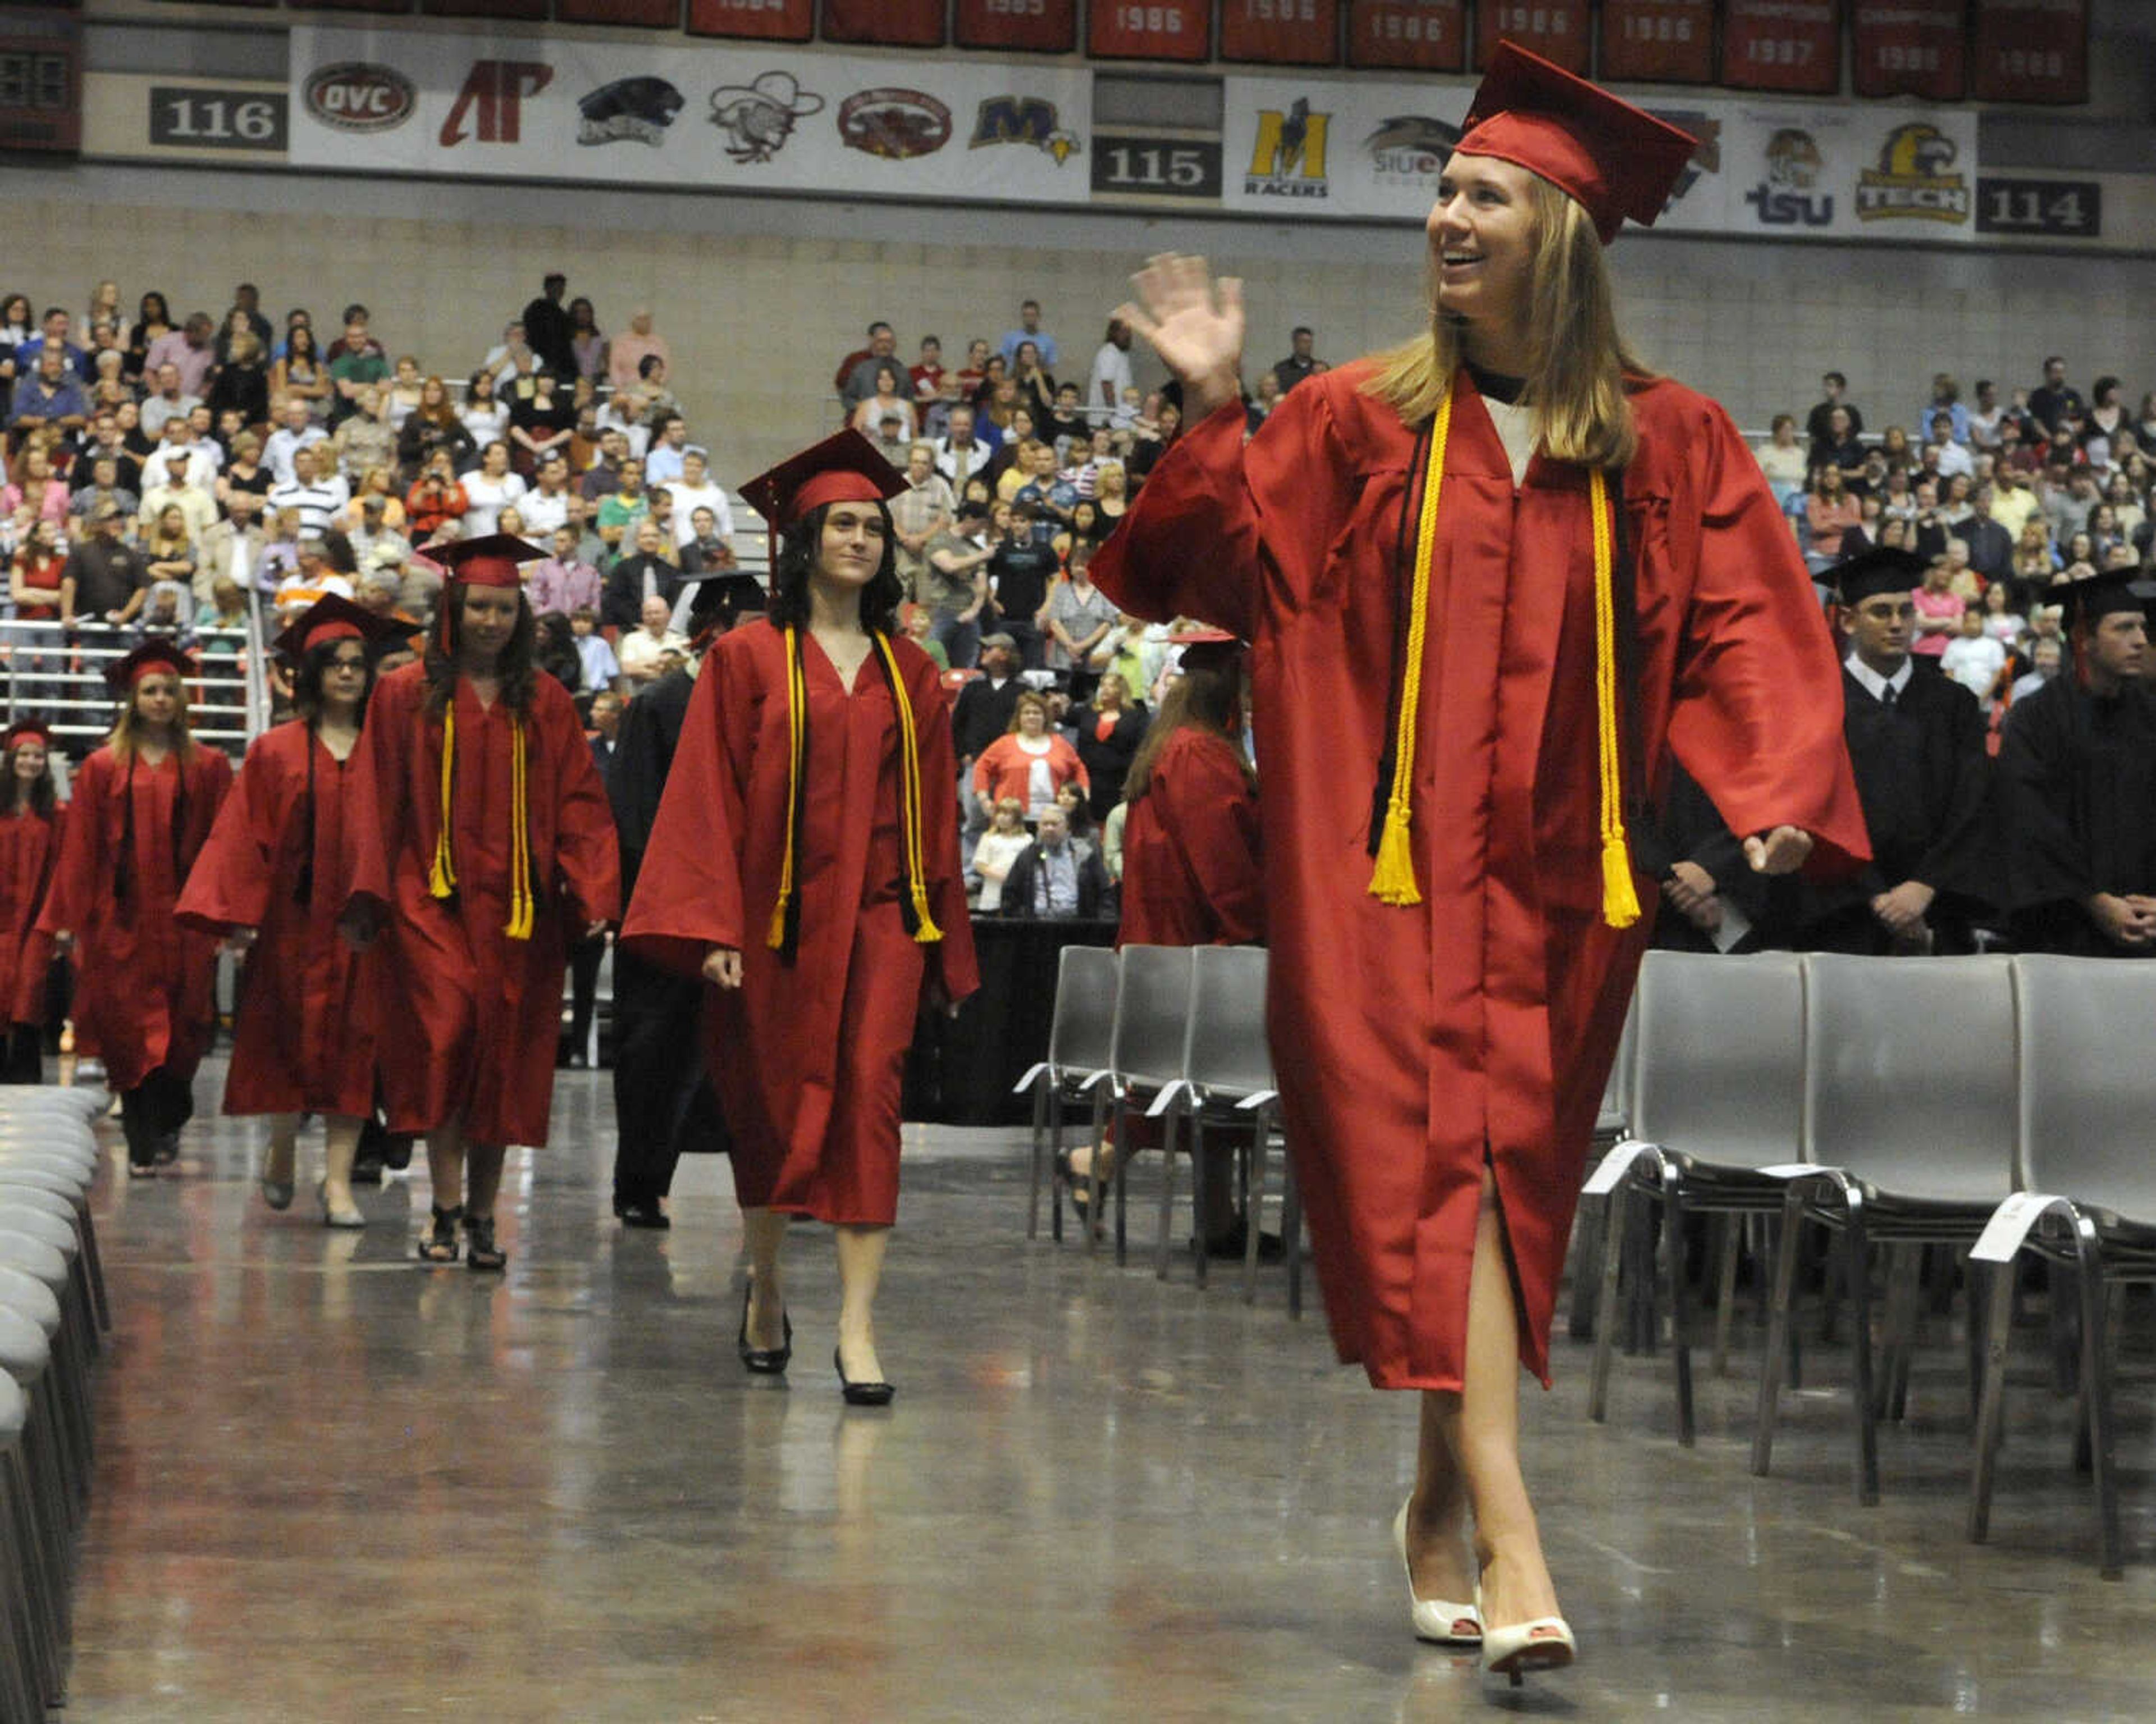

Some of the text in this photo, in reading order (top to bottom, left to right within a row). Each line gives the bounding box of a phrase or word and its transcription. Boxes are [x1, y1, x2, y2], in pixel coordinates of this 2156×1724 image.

[1118, 7, 1182, 32] 1986
[324, 85, 390, 112] OVC
[168, 99, 274, 140] 116
[1107, 148, 1205, 186] 115
[1244, 182, 1328, 198] RACERS
[1858, 185, 1966, 212] TECH
[1990, 189, 2085, 225] 114
